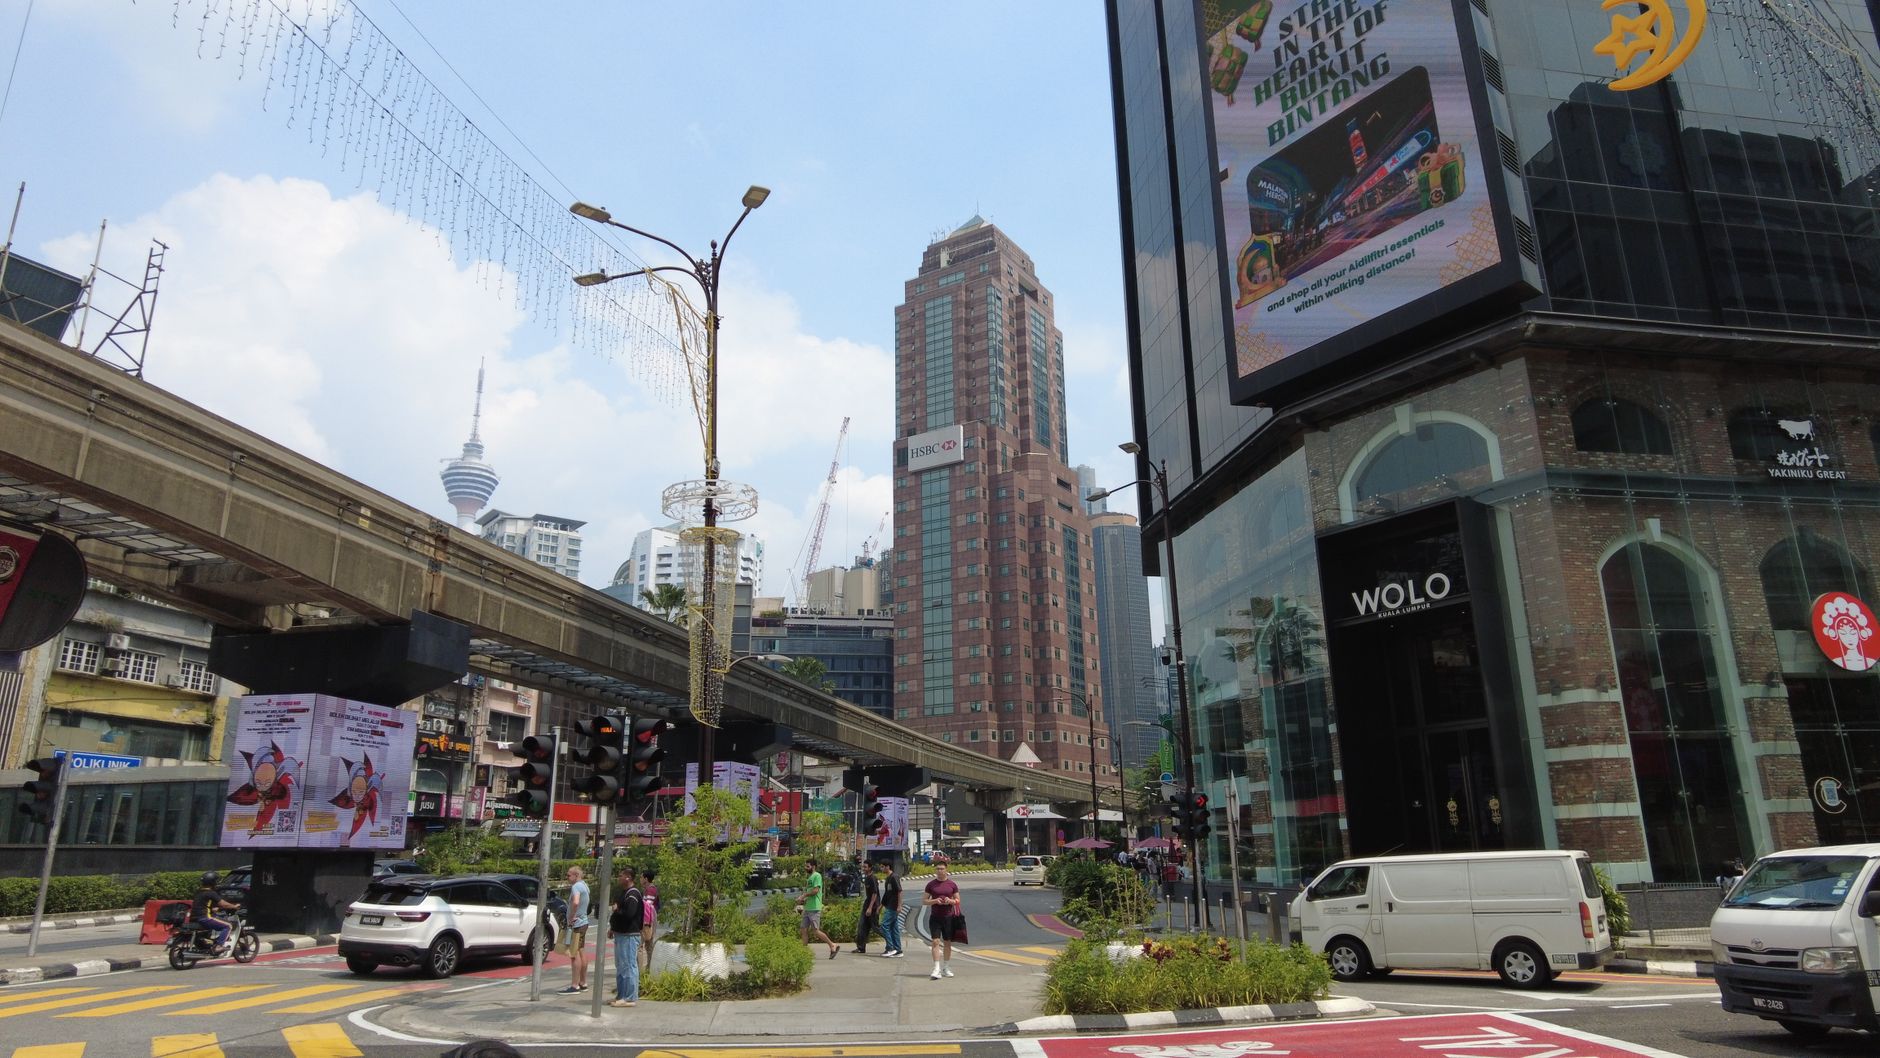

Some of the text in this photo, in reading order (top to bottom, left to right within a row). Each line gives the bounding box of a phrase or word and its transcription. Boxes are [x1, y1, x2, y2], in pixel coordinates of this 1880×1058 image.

[1254, 0, 1389, 107] HEART OF
[1273, 0, 1361, 68] IN THE
[1267, 52, 1390, 147] BINTANG
[1280, 39, 1366, 113] BUKIT
[1267, 219, 1445, 312] and shop all your Aidilfitri essentials
[1294, 248, 1416, 314] within walking distance!
[911, 443, 940, 459] HSBC
[1768, 468, 1846, 480] YAKINIKU GREAT
[1351, 572, 1451, 616] WOLO
[1378, 603, 1431, 618] KUALA LUMPUR
